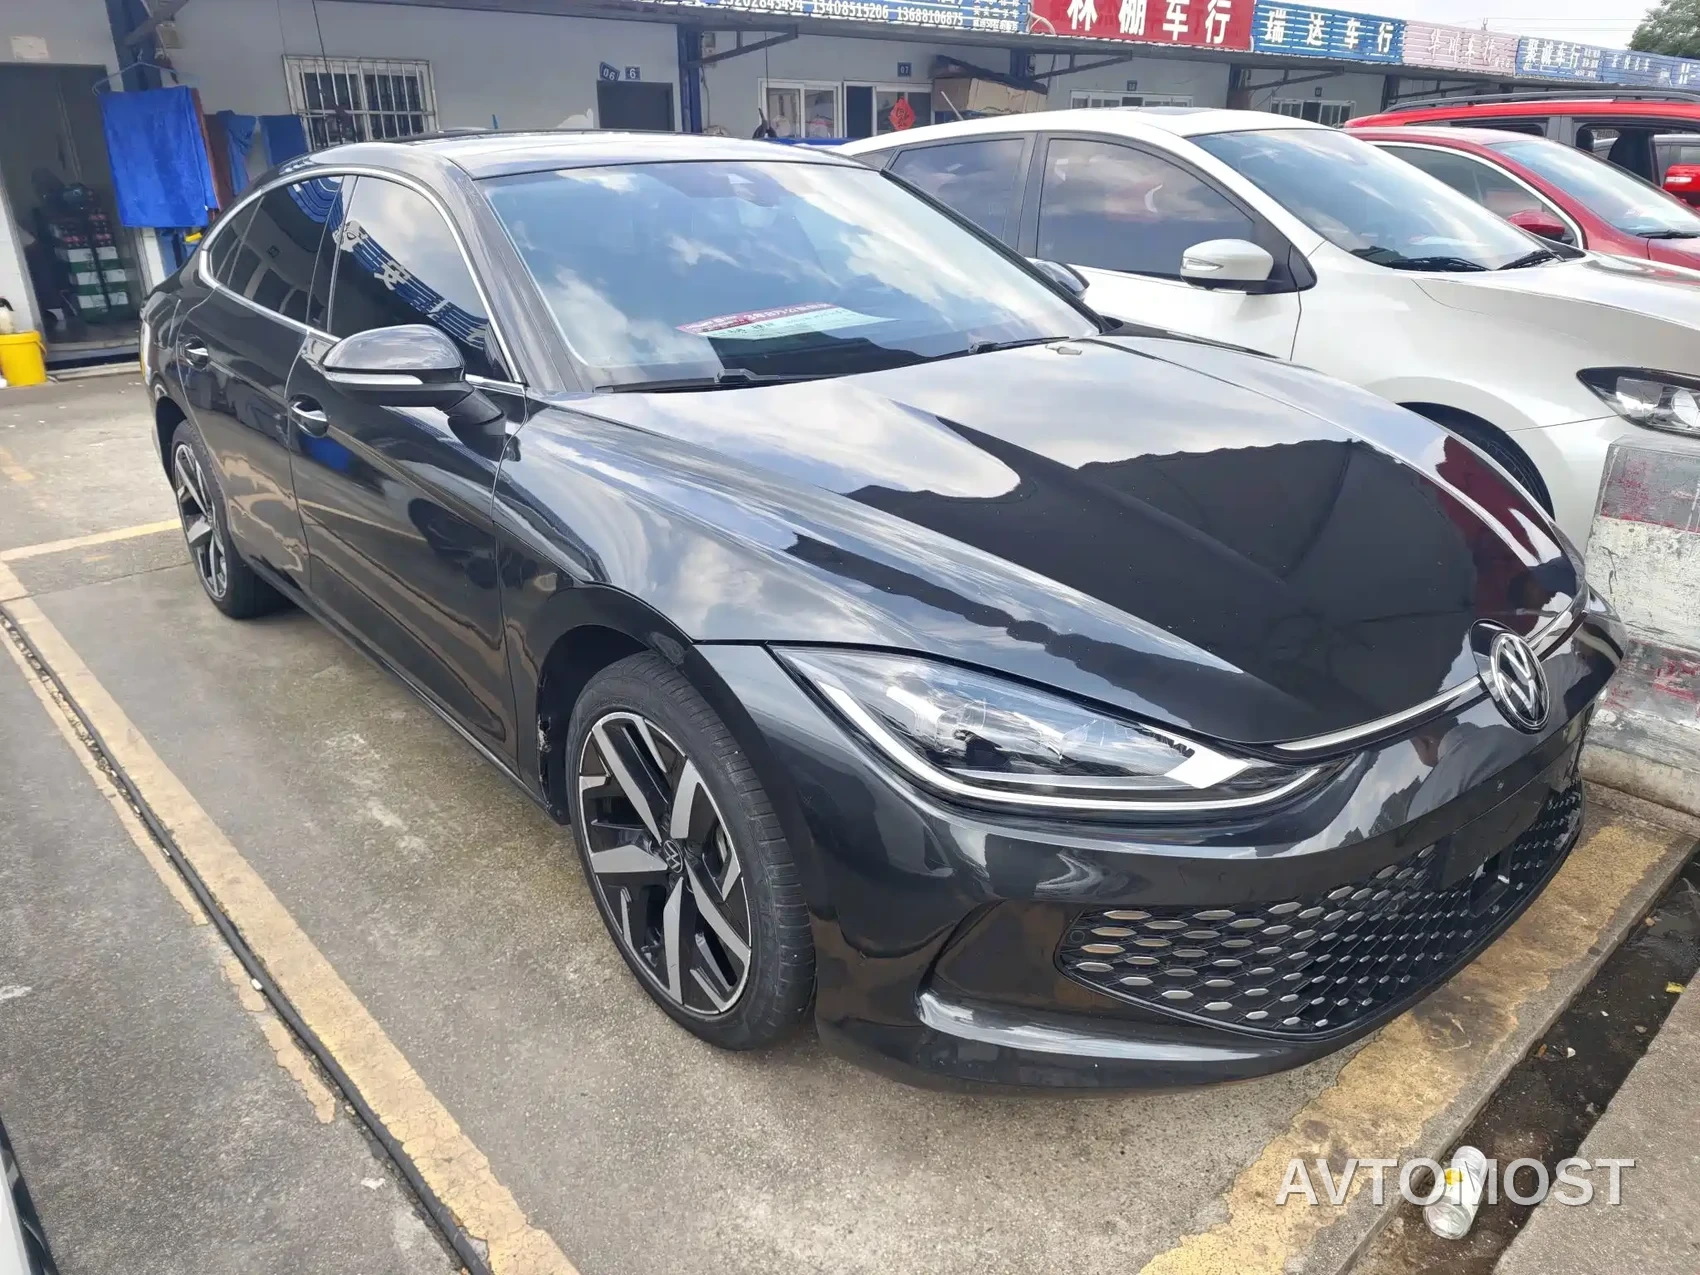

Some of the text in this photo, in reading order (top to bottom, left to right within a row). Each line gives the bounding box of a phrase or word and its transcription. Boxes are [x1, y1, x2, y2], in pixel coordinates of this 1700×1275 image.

[897, 6, 963, 26] 13688106875
[603, 67, 616, 80] 06
[629, 68, 636, 79] 6
